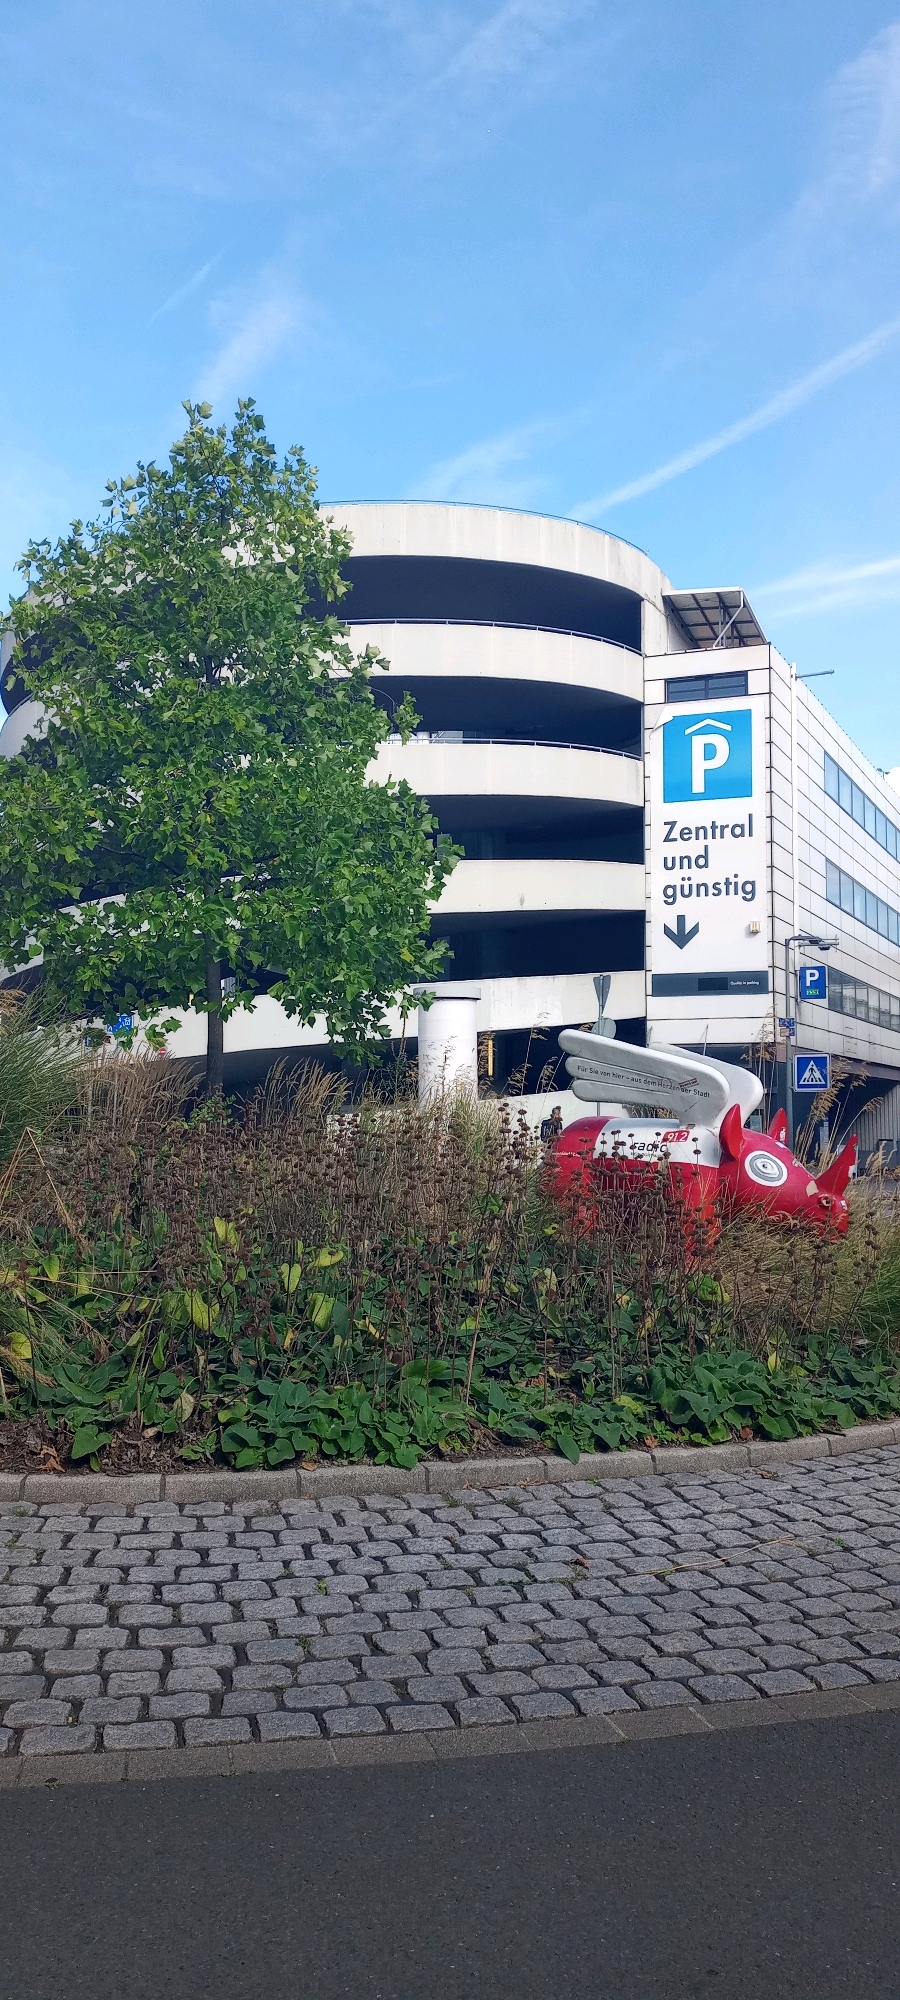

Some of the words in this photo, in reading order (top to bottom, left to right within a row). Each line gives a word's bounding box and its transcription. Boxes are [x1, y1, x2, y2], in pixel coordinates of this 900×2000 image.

[691, 733, 730, 793] P
[662, 813, 753, 842] Zentral
[663, 845, 709, 870] und
[662, 873, 756, 905] günstig
[805, 969, 820, 986] P
[577, 1065, 588, 1073] Für
[589, 1067, 599, 1075] Sie
[612, 1071, 625, 1080] hier
[643, 1078, 657, 1086] dem
[657, 1081, 680, 1091] Herzen
[693, 1088, 711, 1099] Stadt
[667, 1132, 687, 1143] 91.2
